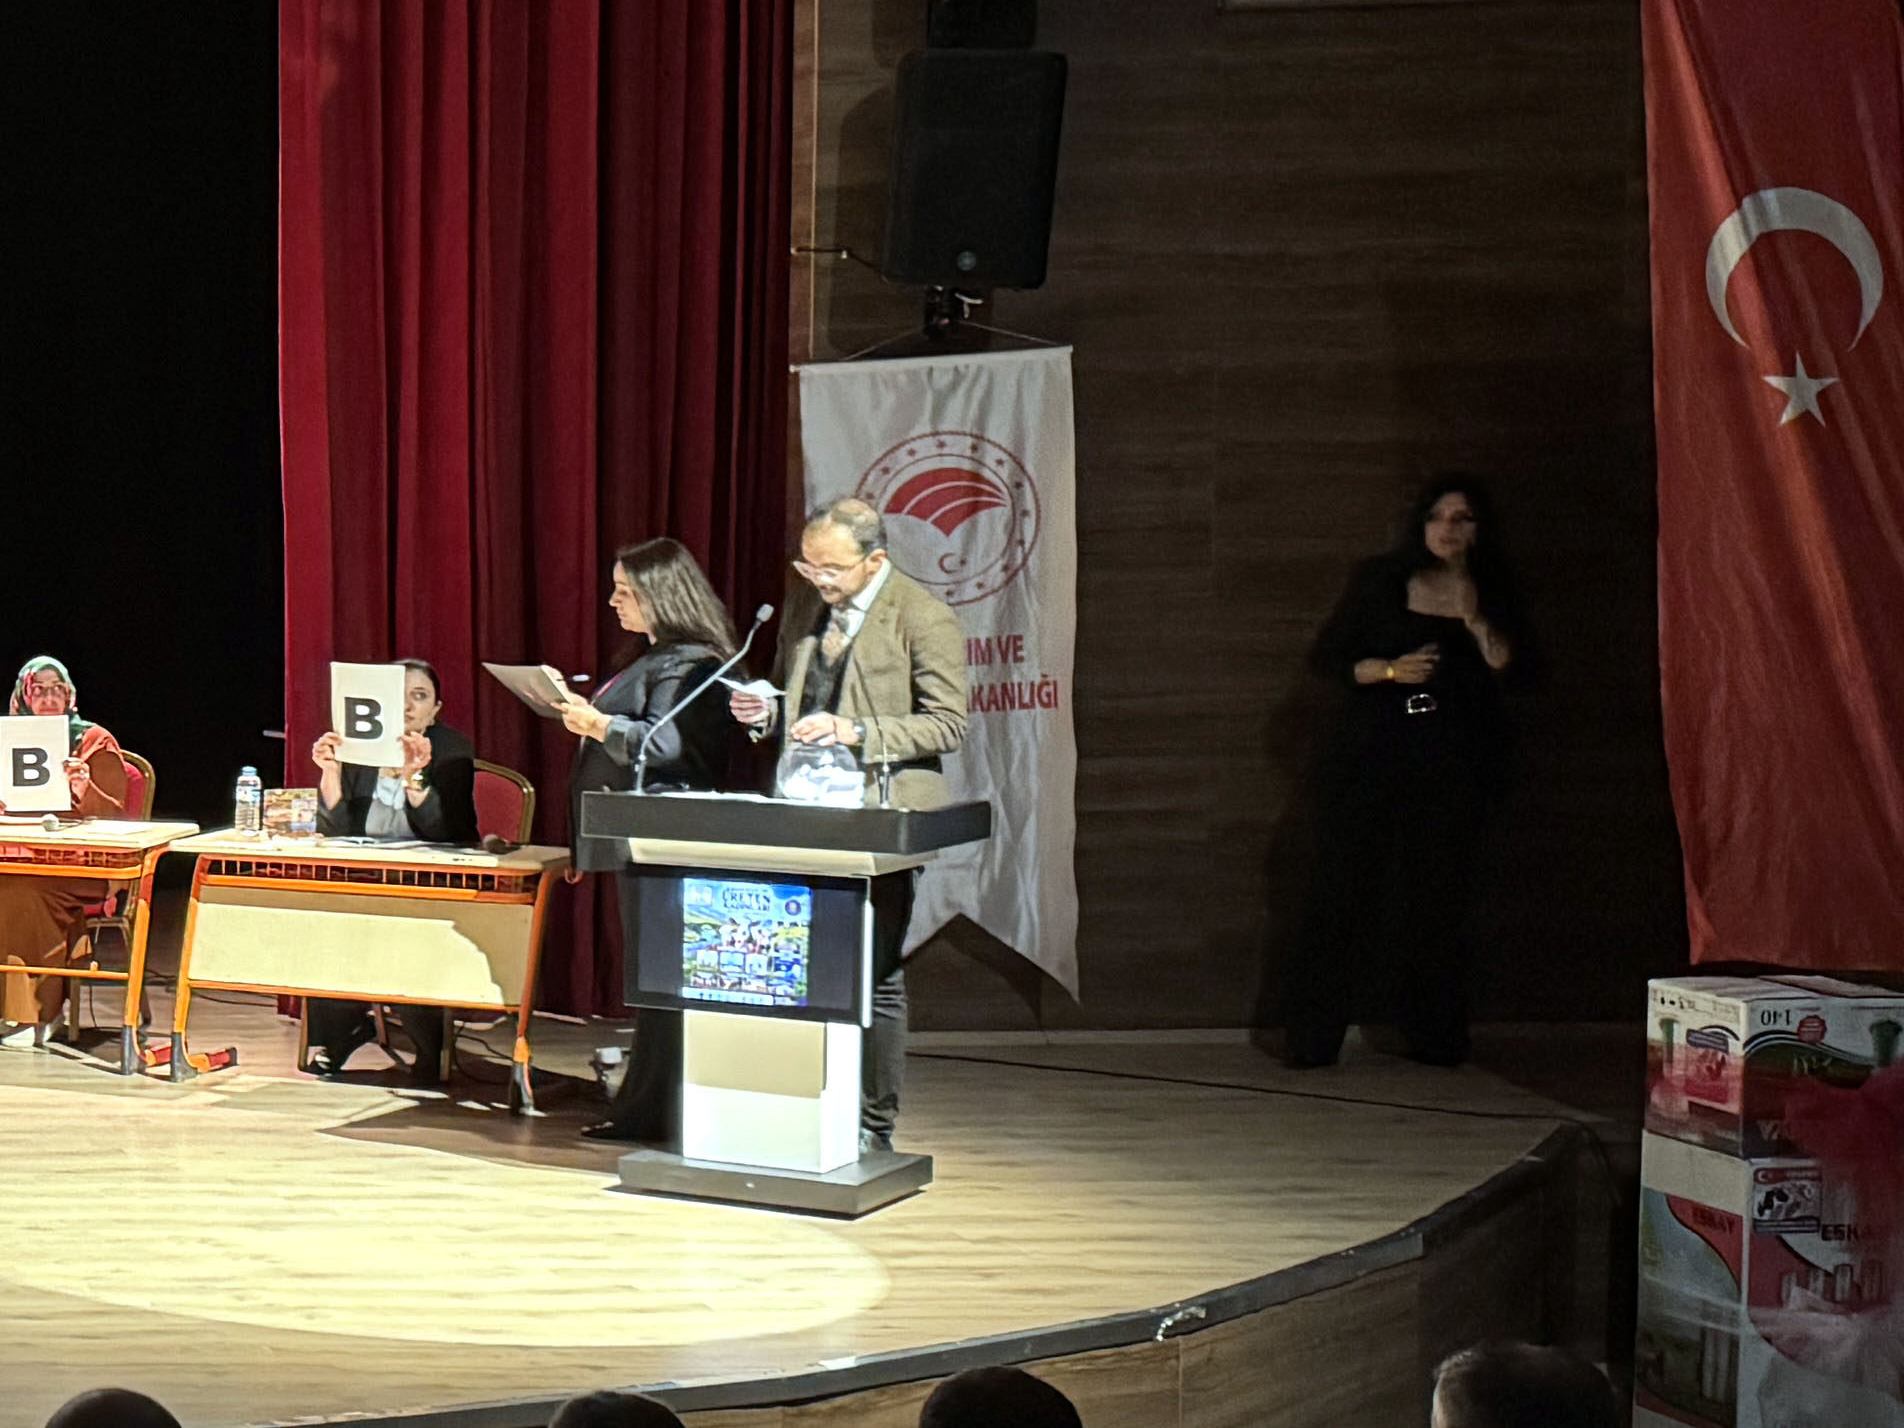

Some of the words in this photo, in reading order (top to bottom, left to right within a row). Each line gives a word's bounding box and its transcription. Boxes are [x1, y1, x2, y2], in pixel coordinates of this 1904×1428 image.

[997, 635, 1024, 663] VE
[967, 674, 1058, 712] KANLIĞI
[345, 697, 383, 740] B
[13, 748, 50, 787] B
